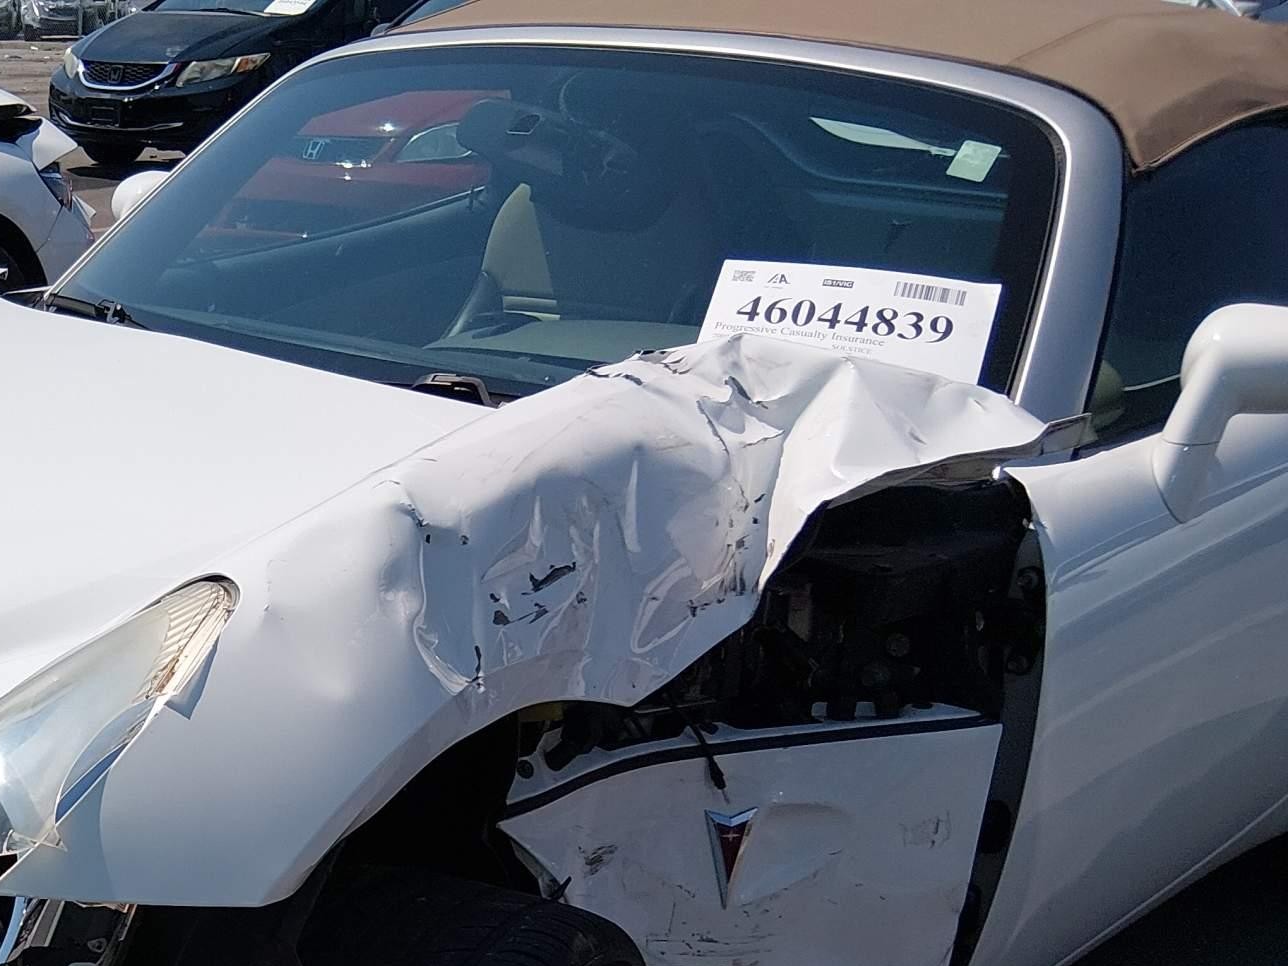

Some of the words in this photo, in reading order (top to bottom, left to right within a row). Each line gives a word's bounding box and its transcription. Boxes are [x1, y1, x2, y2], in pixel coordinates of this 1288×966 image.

[714, 321, 777, 335] Progressive
[780, 326, 828, 341] Casualty
[831, 332, 885, 347] Insurance
[736, 295, 954, 344] 46044839
